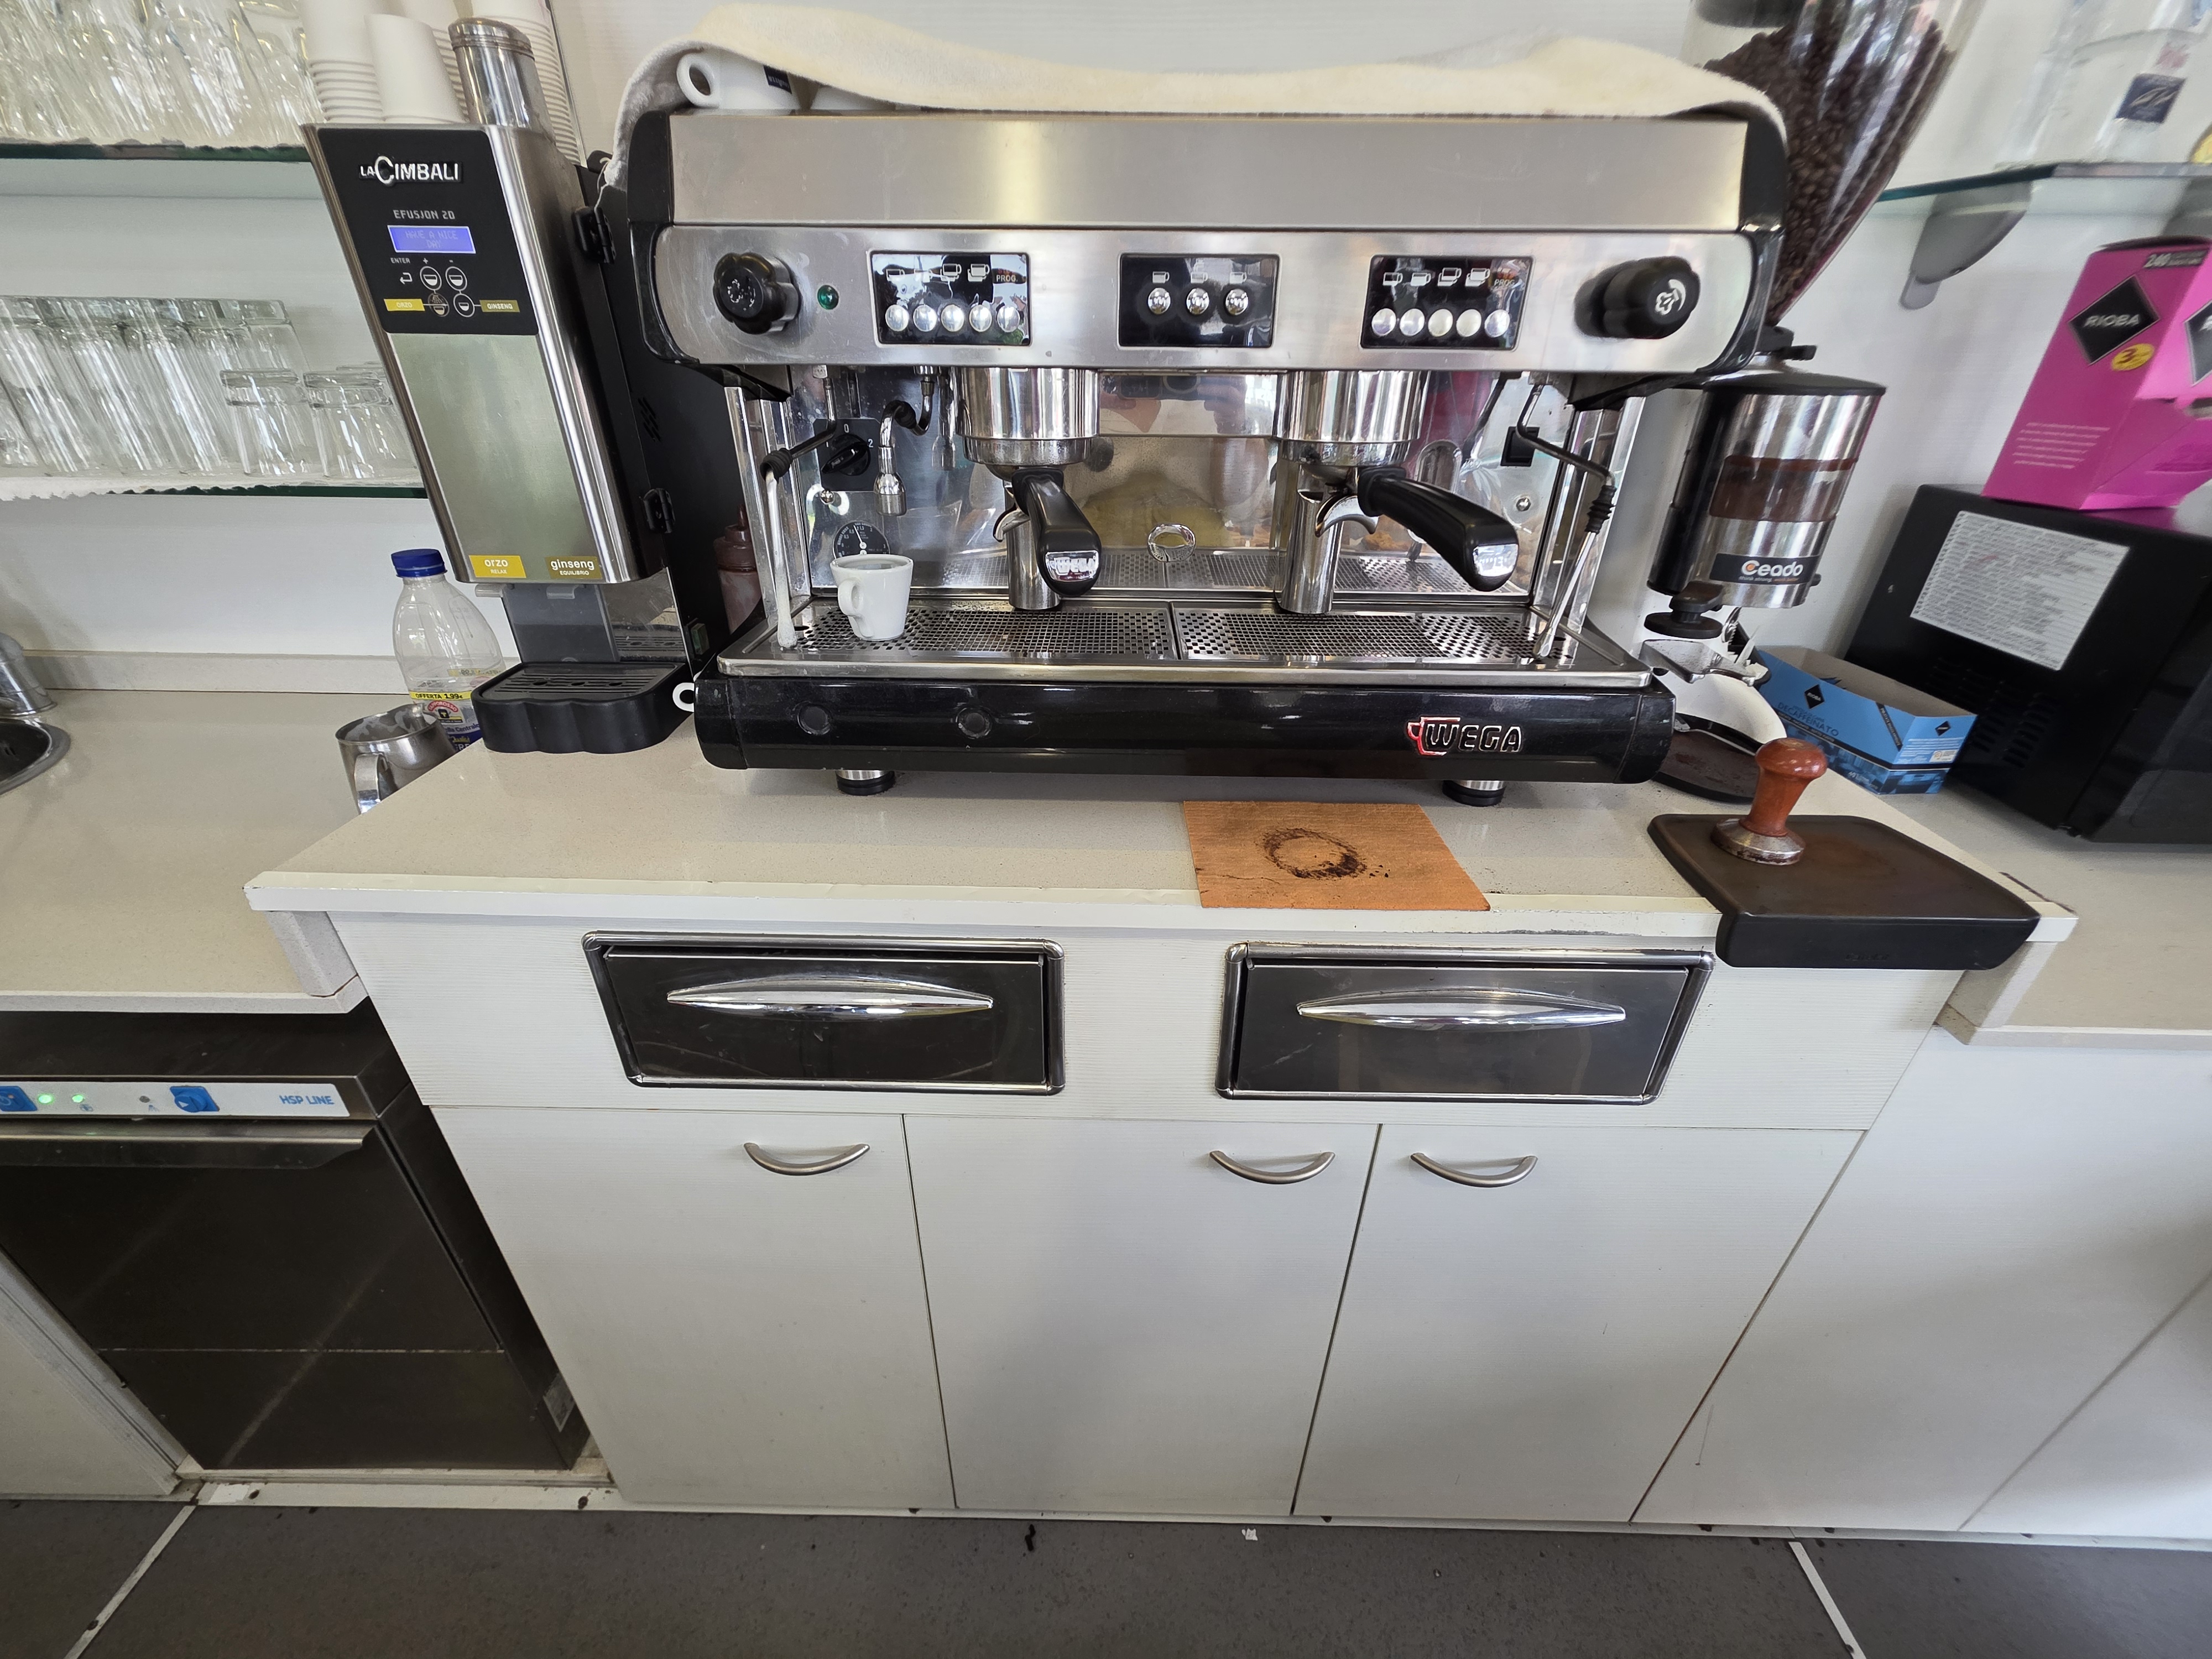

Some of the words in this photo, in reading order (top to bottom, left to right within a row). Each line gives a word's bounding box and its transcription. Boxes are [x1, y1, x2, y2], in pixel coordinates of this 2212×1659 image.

[360, 166, 375, 176] LA
[375, 156, 458, 184] CIMBALI
[442, 211, 456, 220] 2D
[405, 231, 425, 239] HAVE
[429, 231, 435, 239] A
[437, 231, 458, 240] NICE
[426, 240, 441, 248] DAY
[487, 301, 513, 310] GINSENG
[2083, 314, 2140, 327] RIOBA
[843, 424, 849, 433] 0
[867, 439, 874, 448] 2
[484, 559, 508, 567] orzo
[551, 559, 594, 571] ginseng
[1741, 560, 1804, 577] Ceado
[1777, 702, 1839, 737] DECAFFEINATO
[1426, 724, 1522, 752] WEGA
[279, 1095, 304, 1104] HSP
[305, 1095, 335, 1104] LINE
